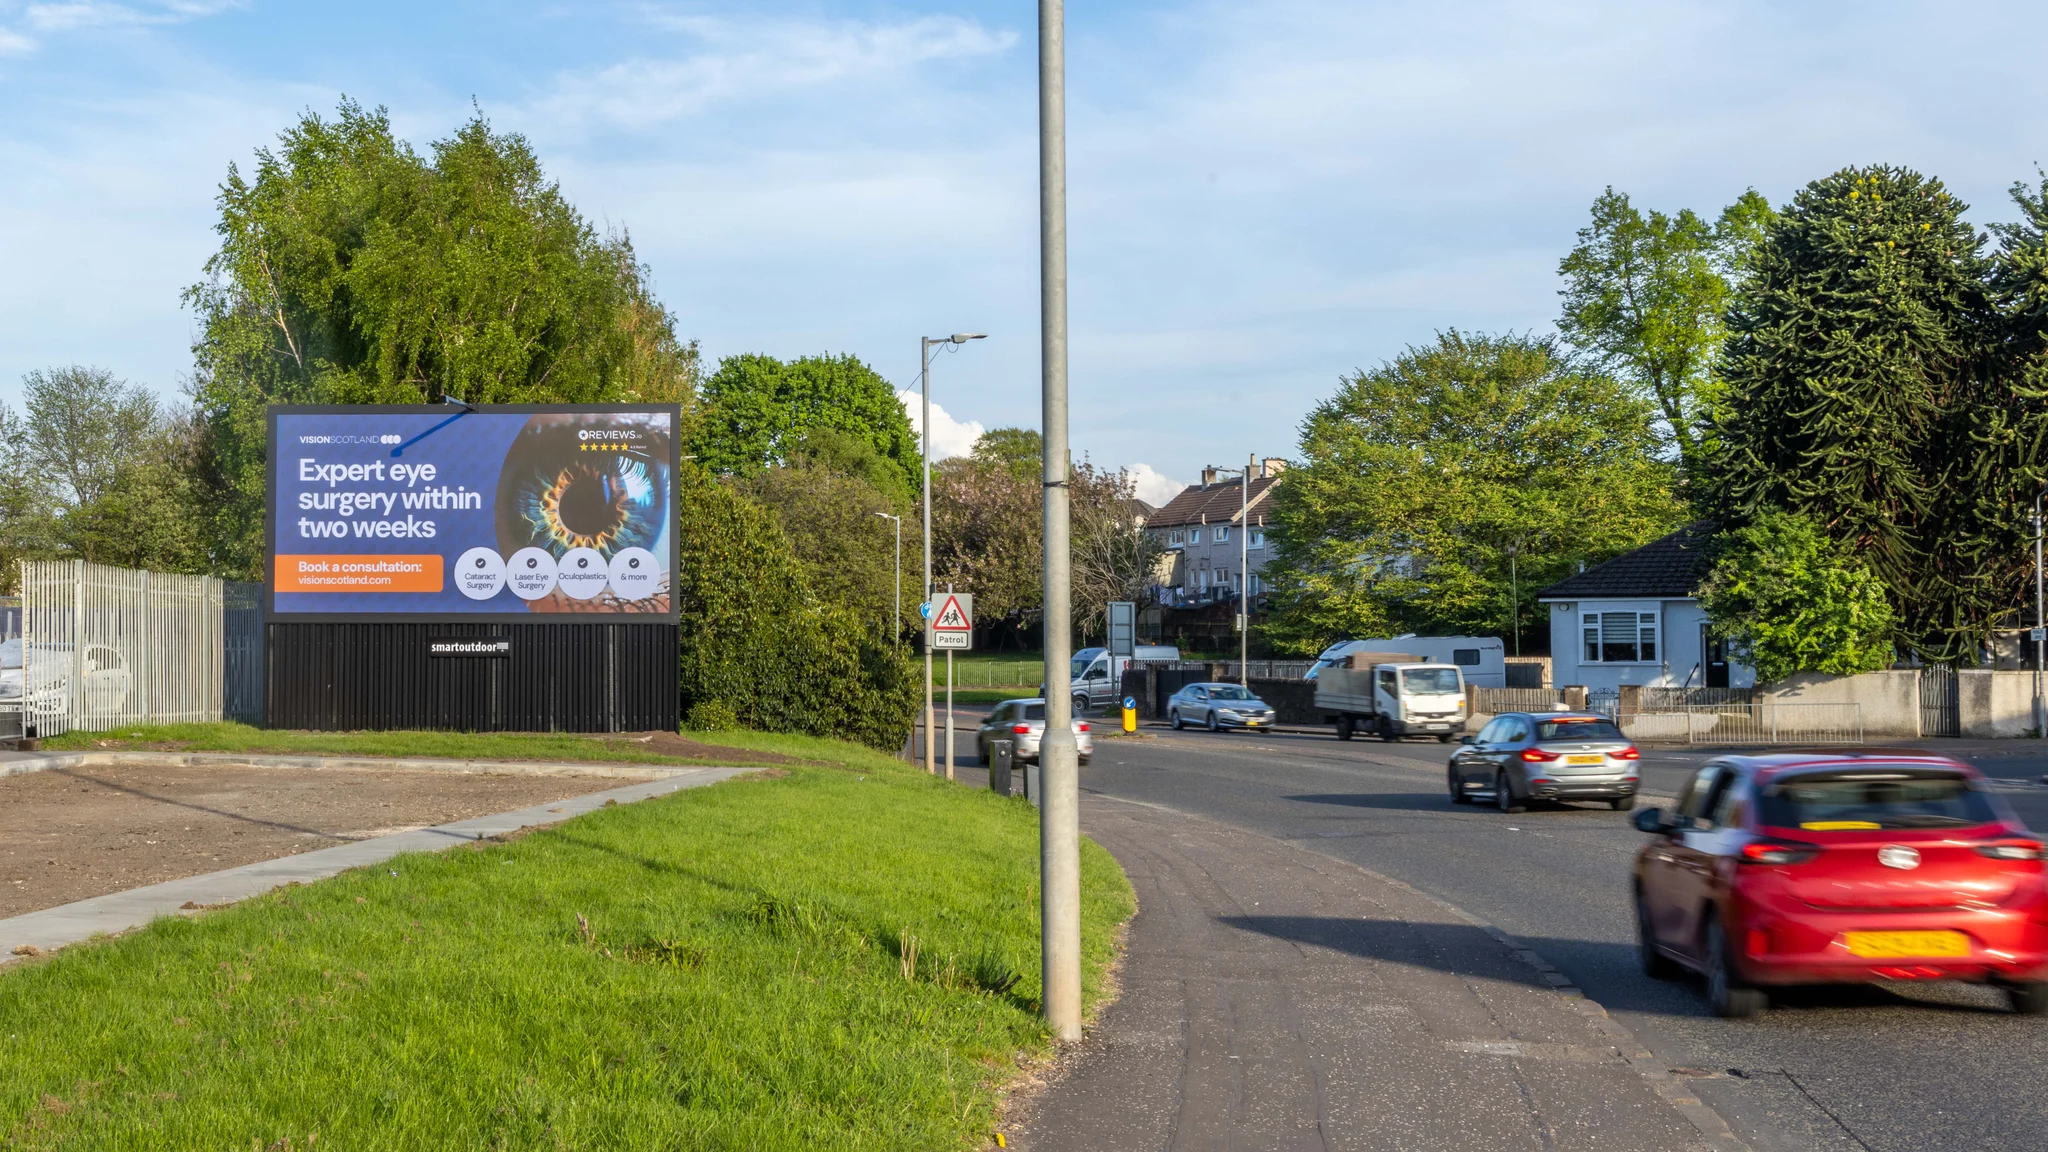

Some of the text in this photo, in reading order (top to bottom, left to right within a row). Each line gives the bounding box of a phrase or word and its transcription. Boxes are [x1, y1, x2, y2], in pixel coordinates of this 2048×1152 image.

[299, 435, 380, 444] VISIONSCOTLAND
[299, 458, 437, 488] Expert eye
[298, 486, 482, 516] surgery within
[297, 514, 437, 538] two weeks
[298, 560, 423, 573] Book a consultation:
[298, 575, 391, 585] visionscotland.com
[464, 572, 497, 581] Cataract
[514, 573, 549, 583] Laser Eye
[558, 572, 607, 582] Oculoplastics
[620, 573, 627, 581] &
[466, 581, 495, 591] Surgery
[517, 581, 546, 591] Surgery
[938, 635, 964, 644] Patrol
[431, 641, 497, 652] smartoutdoor
